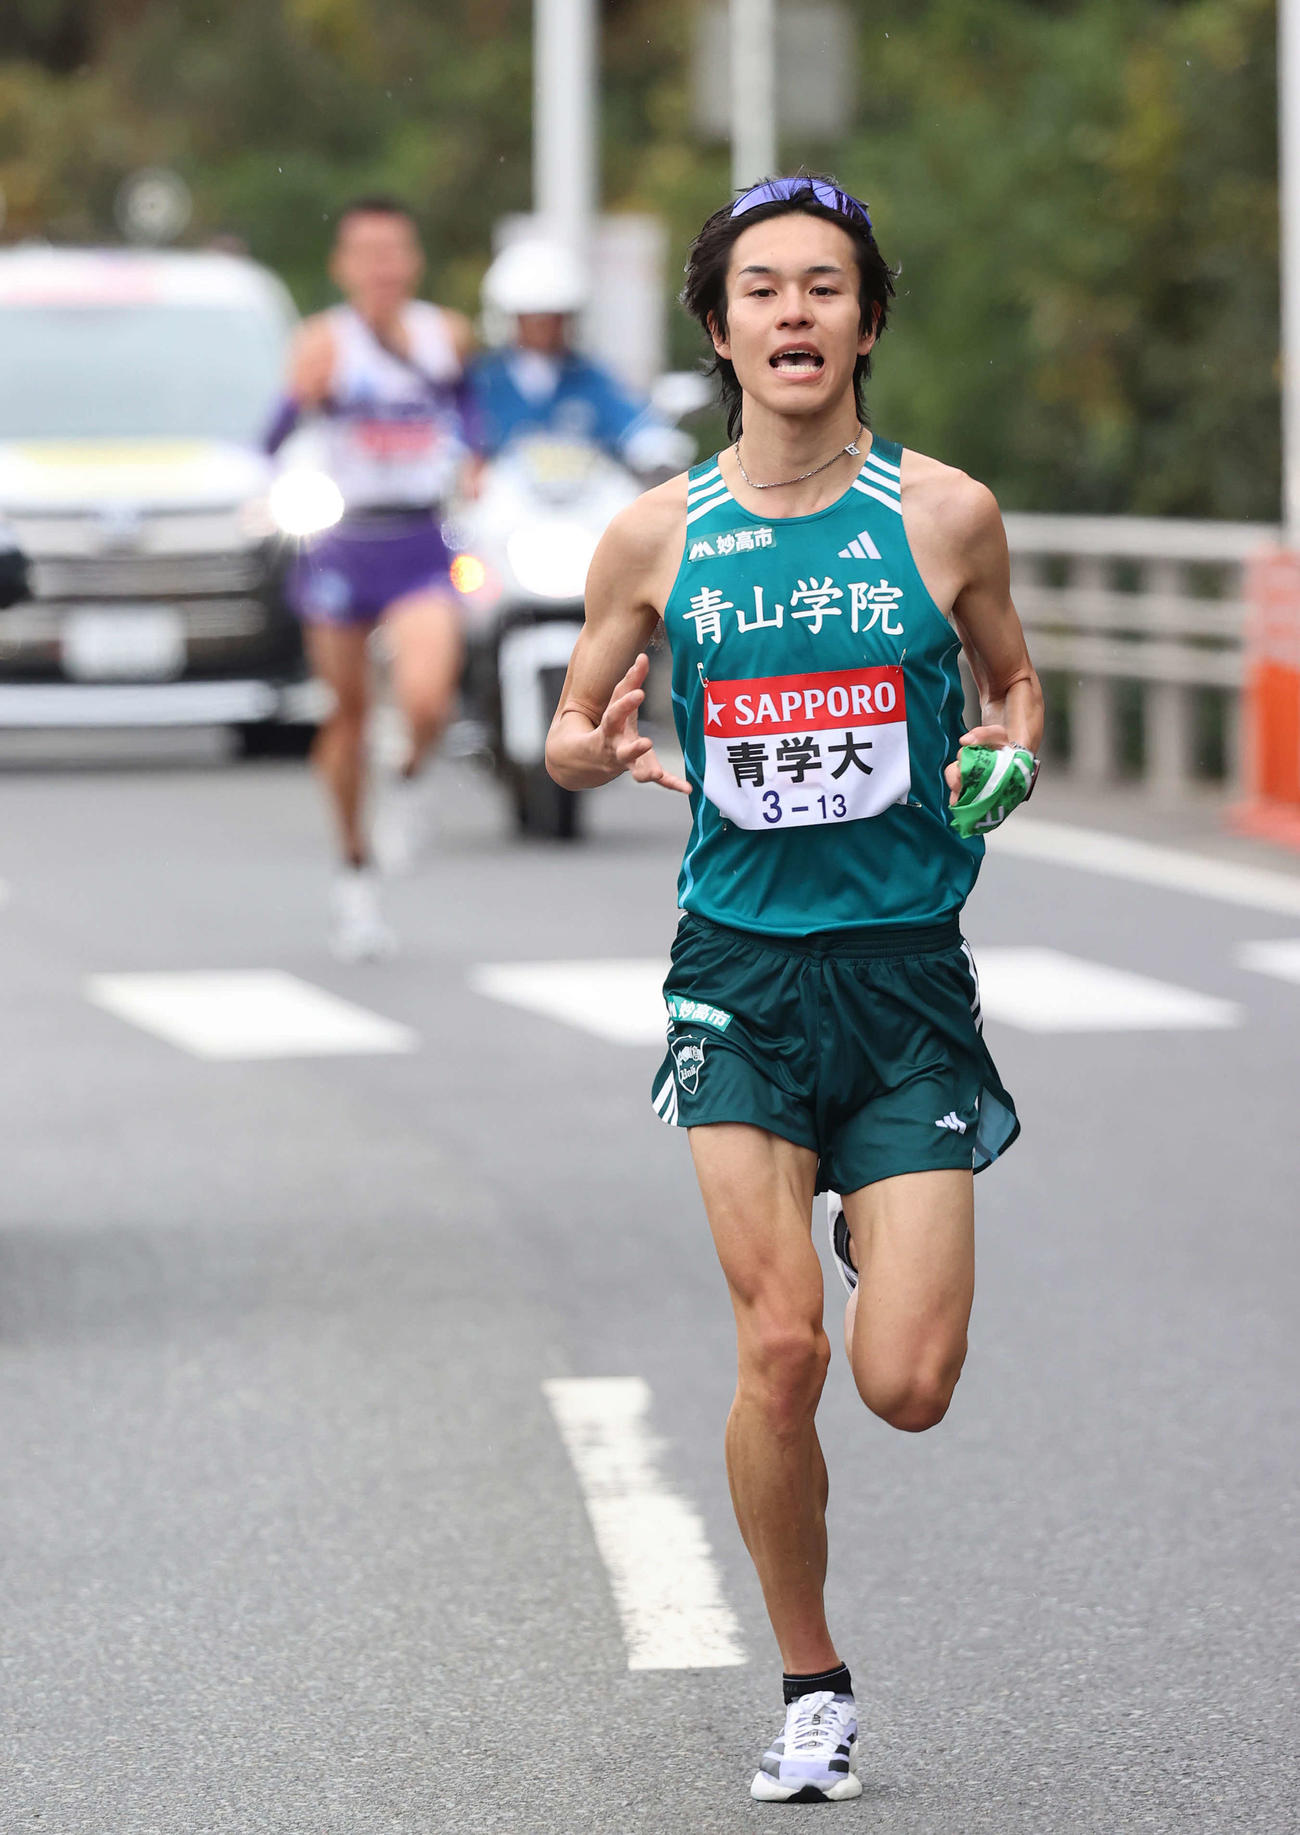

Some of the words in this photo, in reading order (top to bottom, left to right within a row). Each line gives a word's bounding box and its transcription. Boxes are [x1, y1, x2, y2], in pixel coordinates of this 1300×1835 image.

[716, 528, 773, 556] 妙高市
[682, 576, 904, 645] 青山学院
[734, 681, 896, 726] SAPPORO
[726, 731, 874, 788] 青学大
